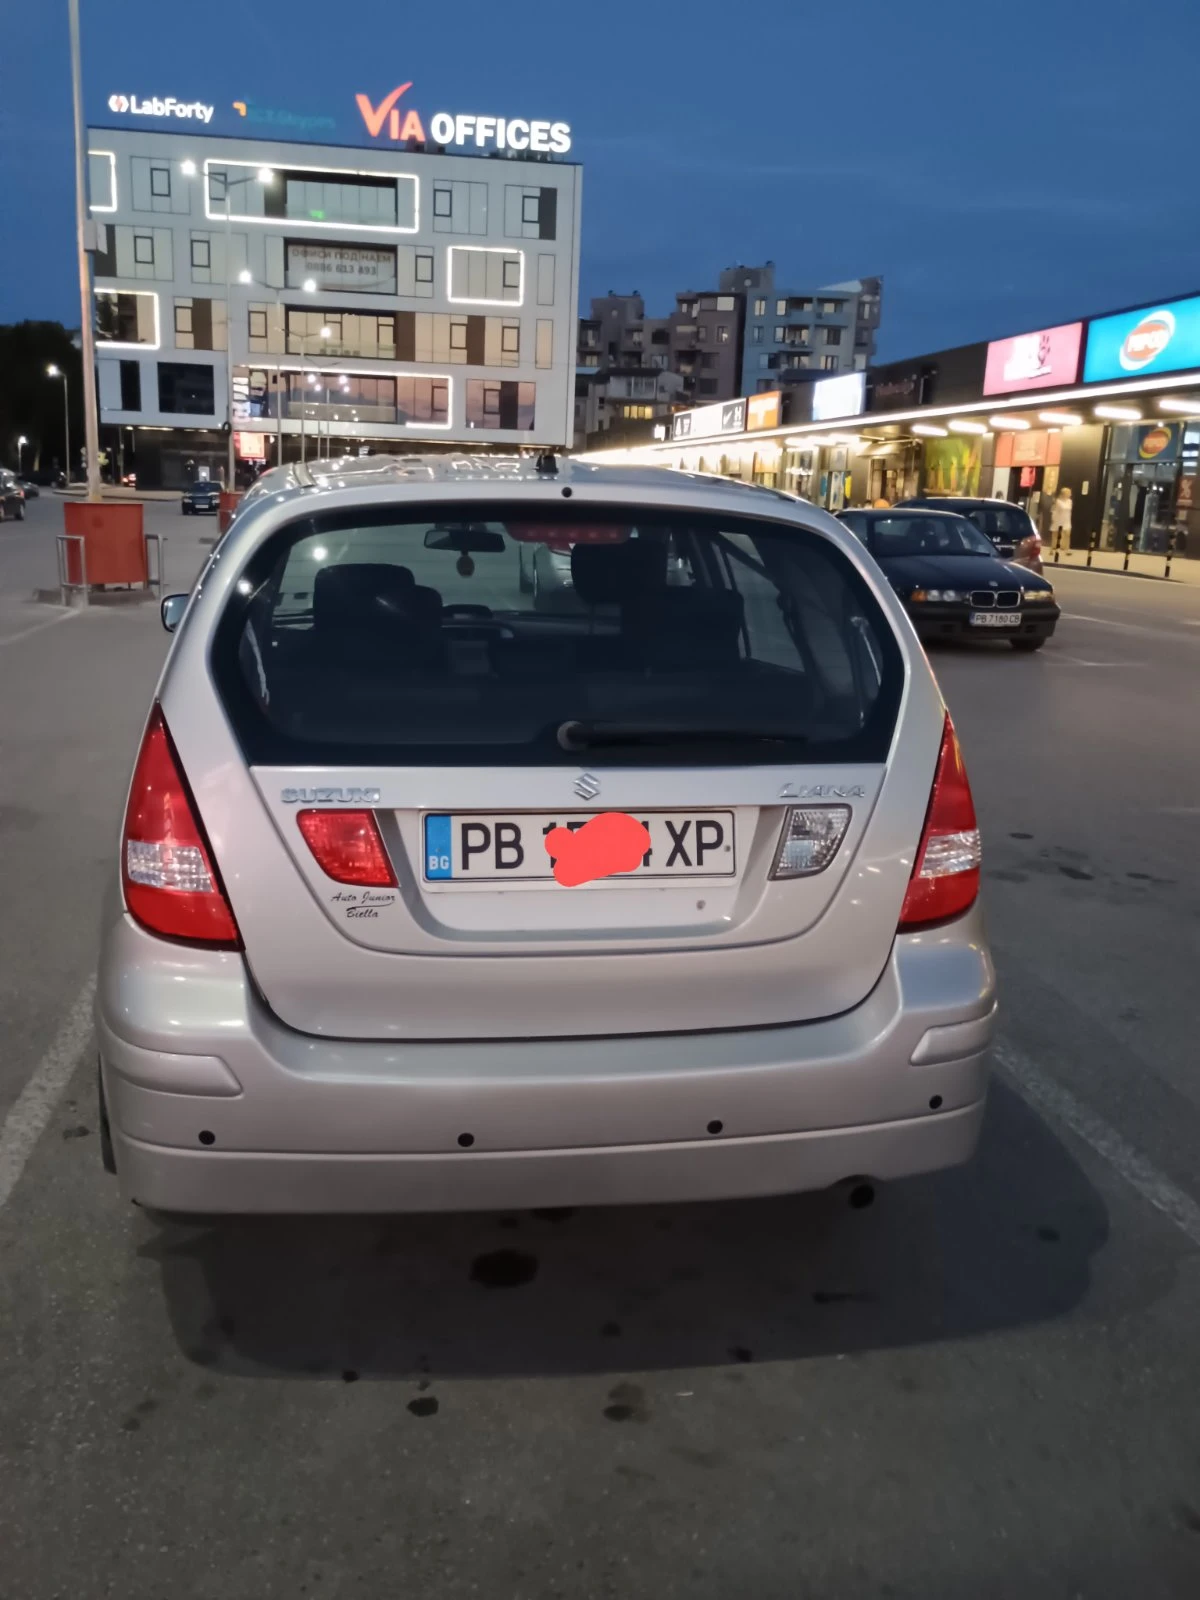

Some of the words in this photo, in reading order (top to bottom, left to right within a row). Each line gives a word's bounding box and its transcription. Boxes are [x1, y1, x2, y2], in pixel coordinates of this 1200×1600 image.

[130, 94, 214, 123] LabForty
[355, 81, 426, 142] VIA
[431, 112, 572, 154] OFFICES
[334, 250, 359, 262] ПОД
[975, 614, 987, 624] PB
[281, 787, 381, 804] SUZUKI
[779, 782, 865, 799] LIANA
[461, 822, 524, 870] PB
[664, 819, 724, 867] XP
[428, 855, 450, 870] BG
[331, 892, 357, 902] Auto
[361, 891, 396, 905] Junior
[346, 906, 379, 919] Biella
